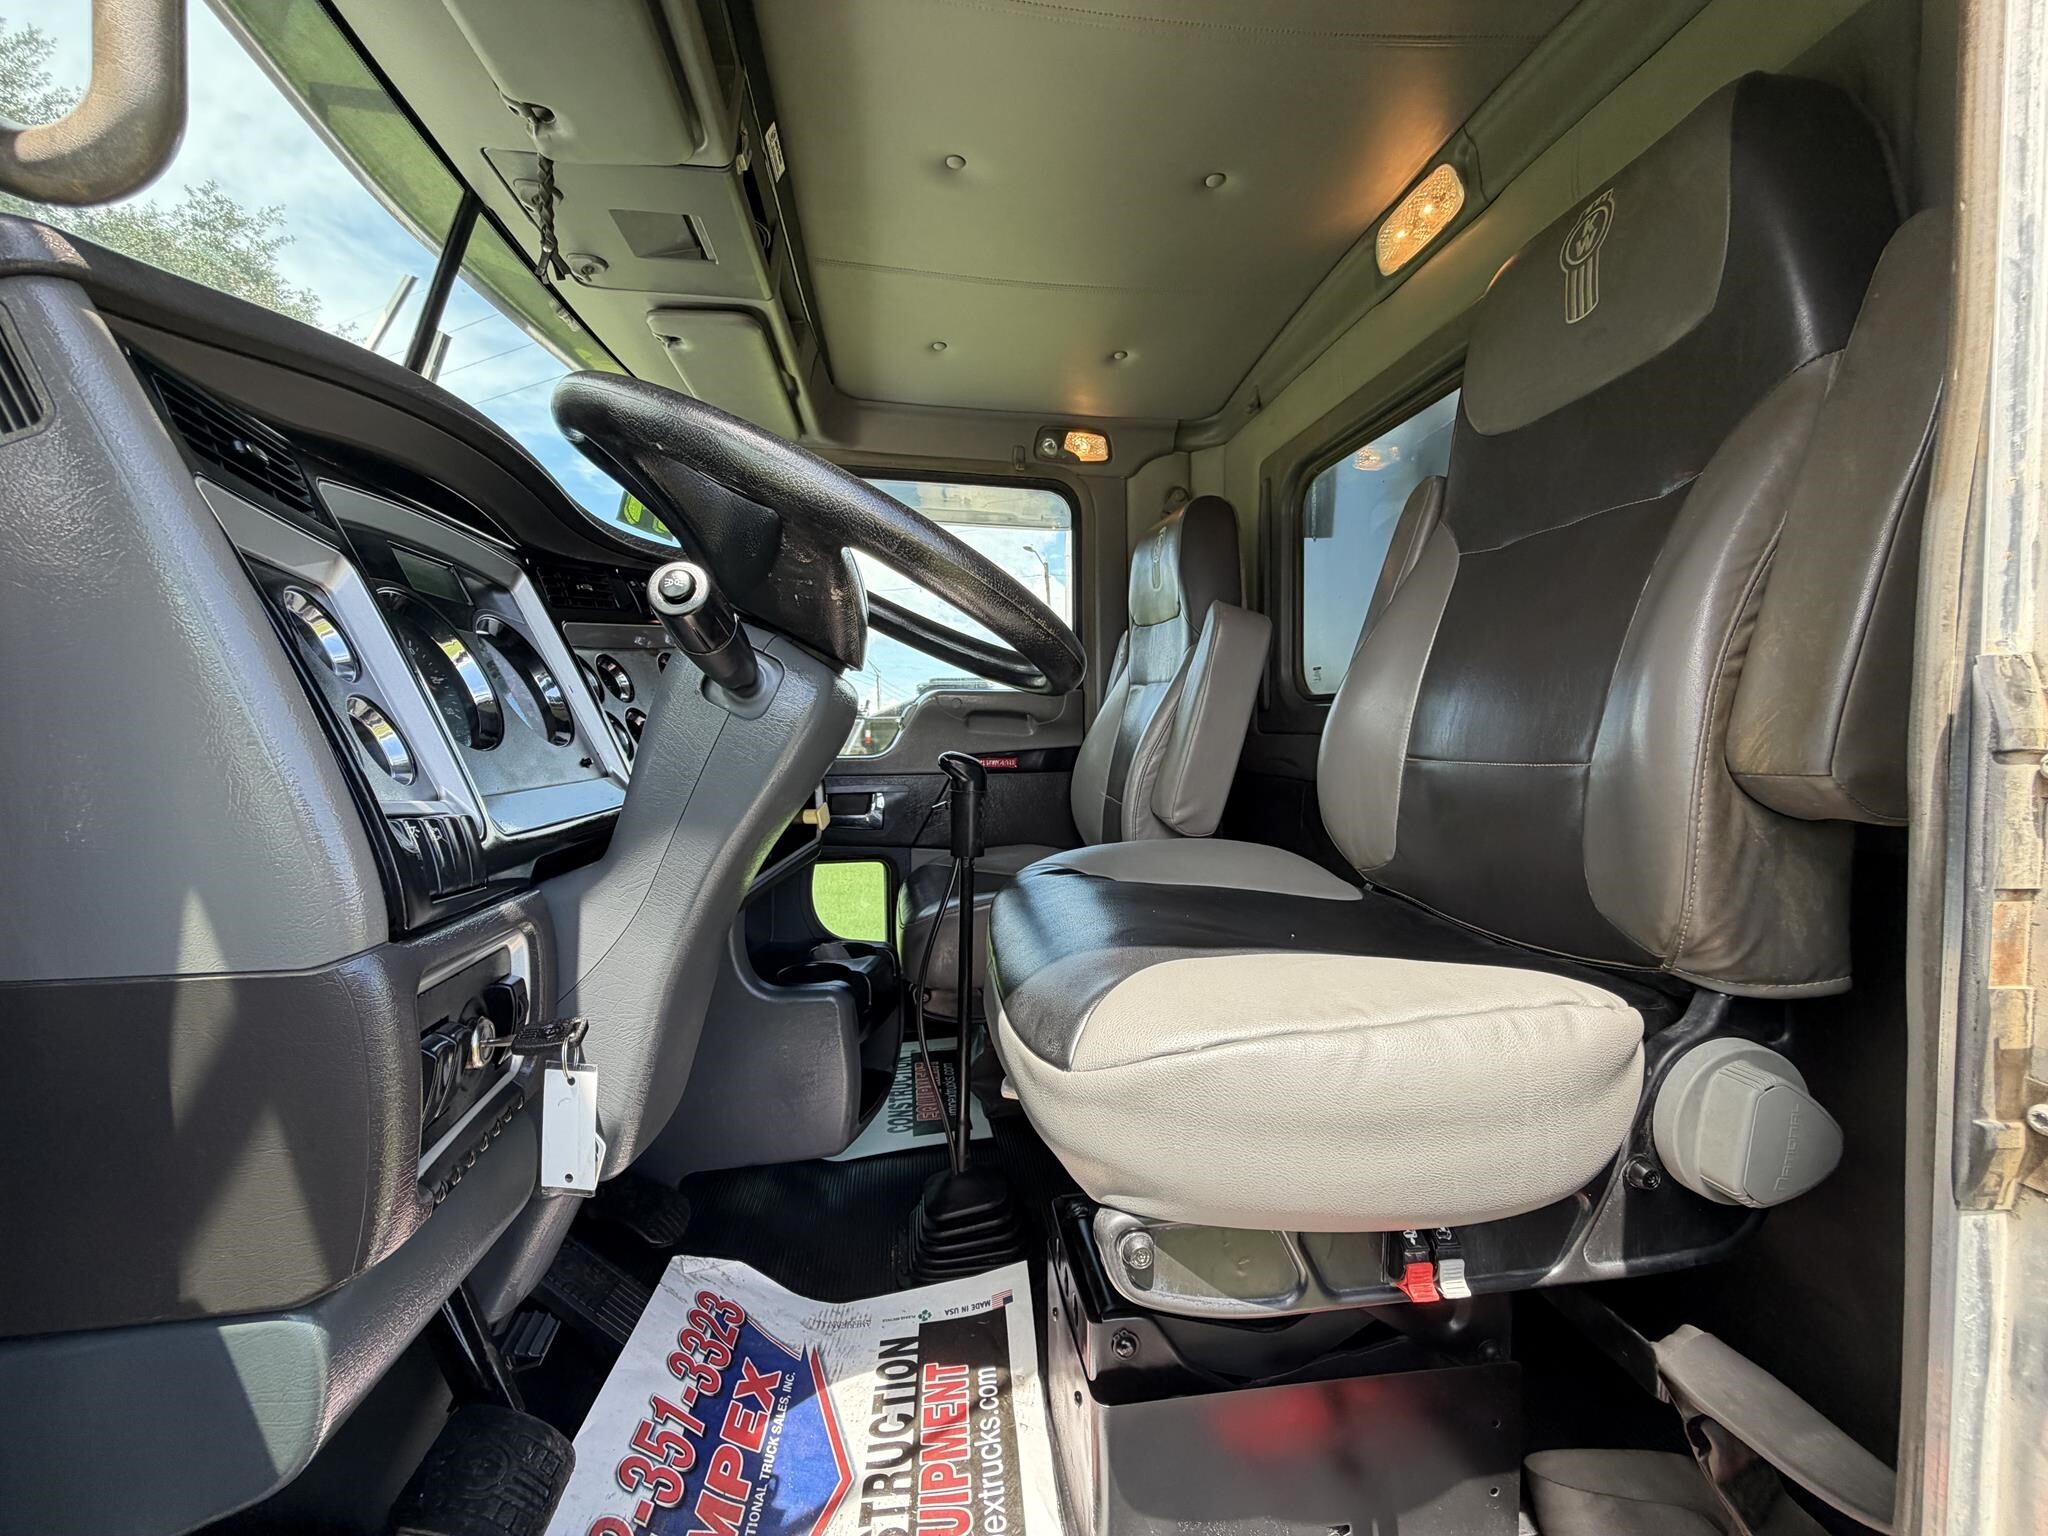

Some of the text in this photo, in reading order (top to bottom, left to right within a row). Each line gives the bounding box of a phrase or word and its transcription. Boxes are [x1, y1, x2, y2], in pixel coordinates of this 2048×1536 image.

[944, 1299, 991, 1316] MADE IN USA
[759, 1435, 780, 1480] TRUCK
[771, 1395, 791, 1435] SALES,
[782, 1371, 796, 1393] INC.
